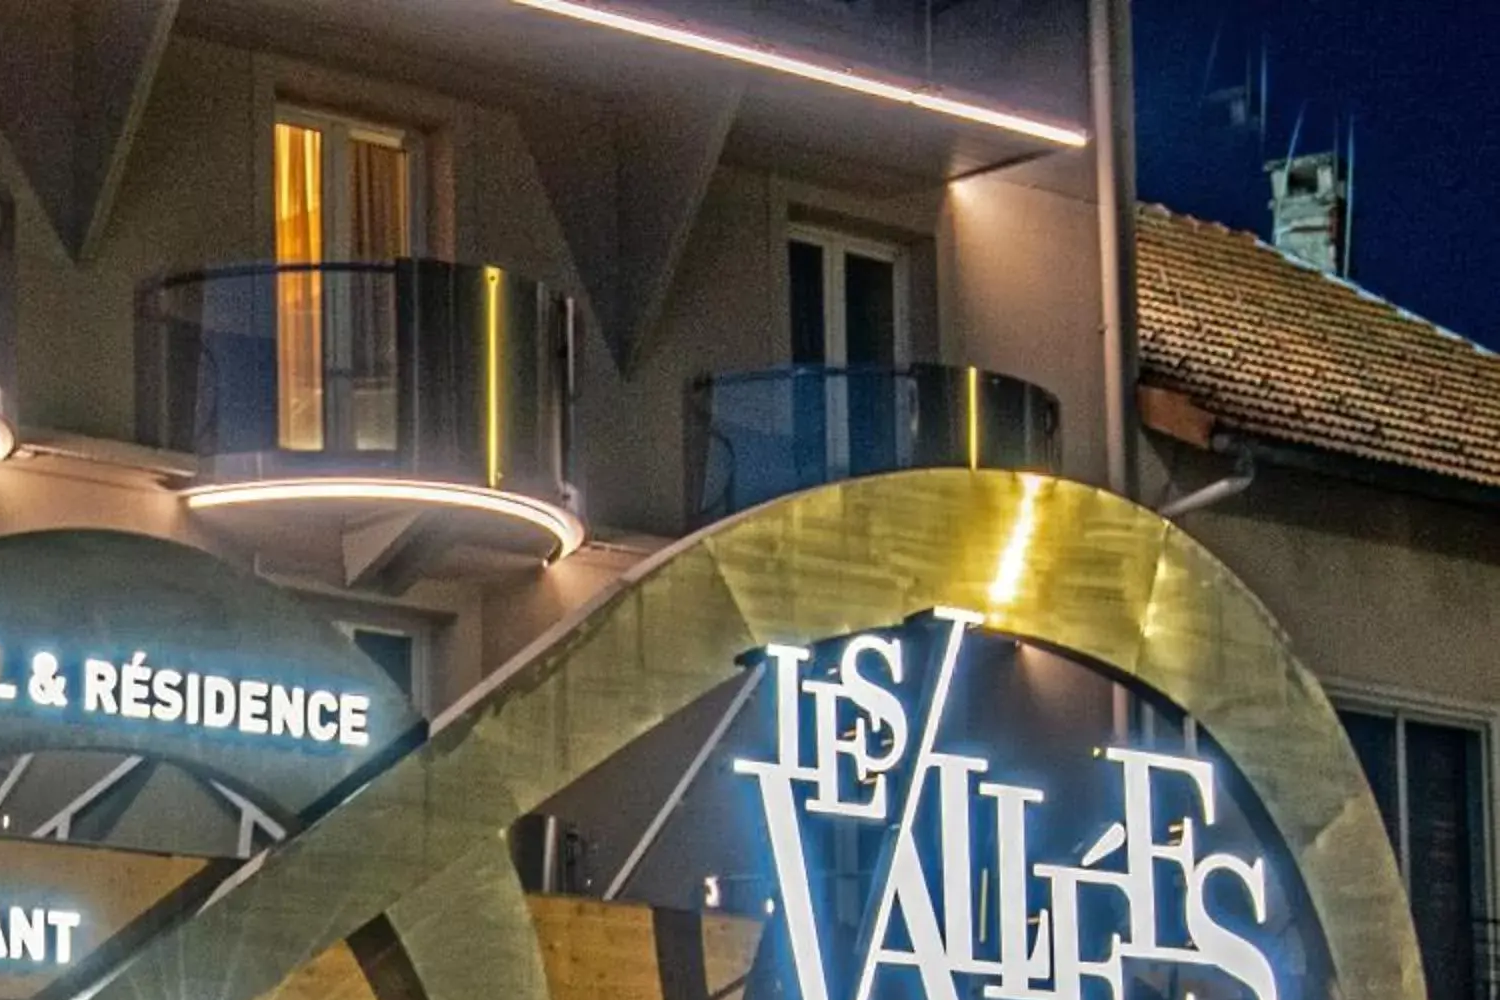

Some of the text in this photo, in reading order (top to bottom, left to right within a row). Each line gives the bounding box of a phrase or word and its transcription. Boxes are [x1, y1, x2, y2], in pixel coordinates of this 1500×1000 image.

[28, 651, 68, 707] &
[84, 651, 370, 747] RÉSIDENCE
[765, 634, 908, 819] LES
